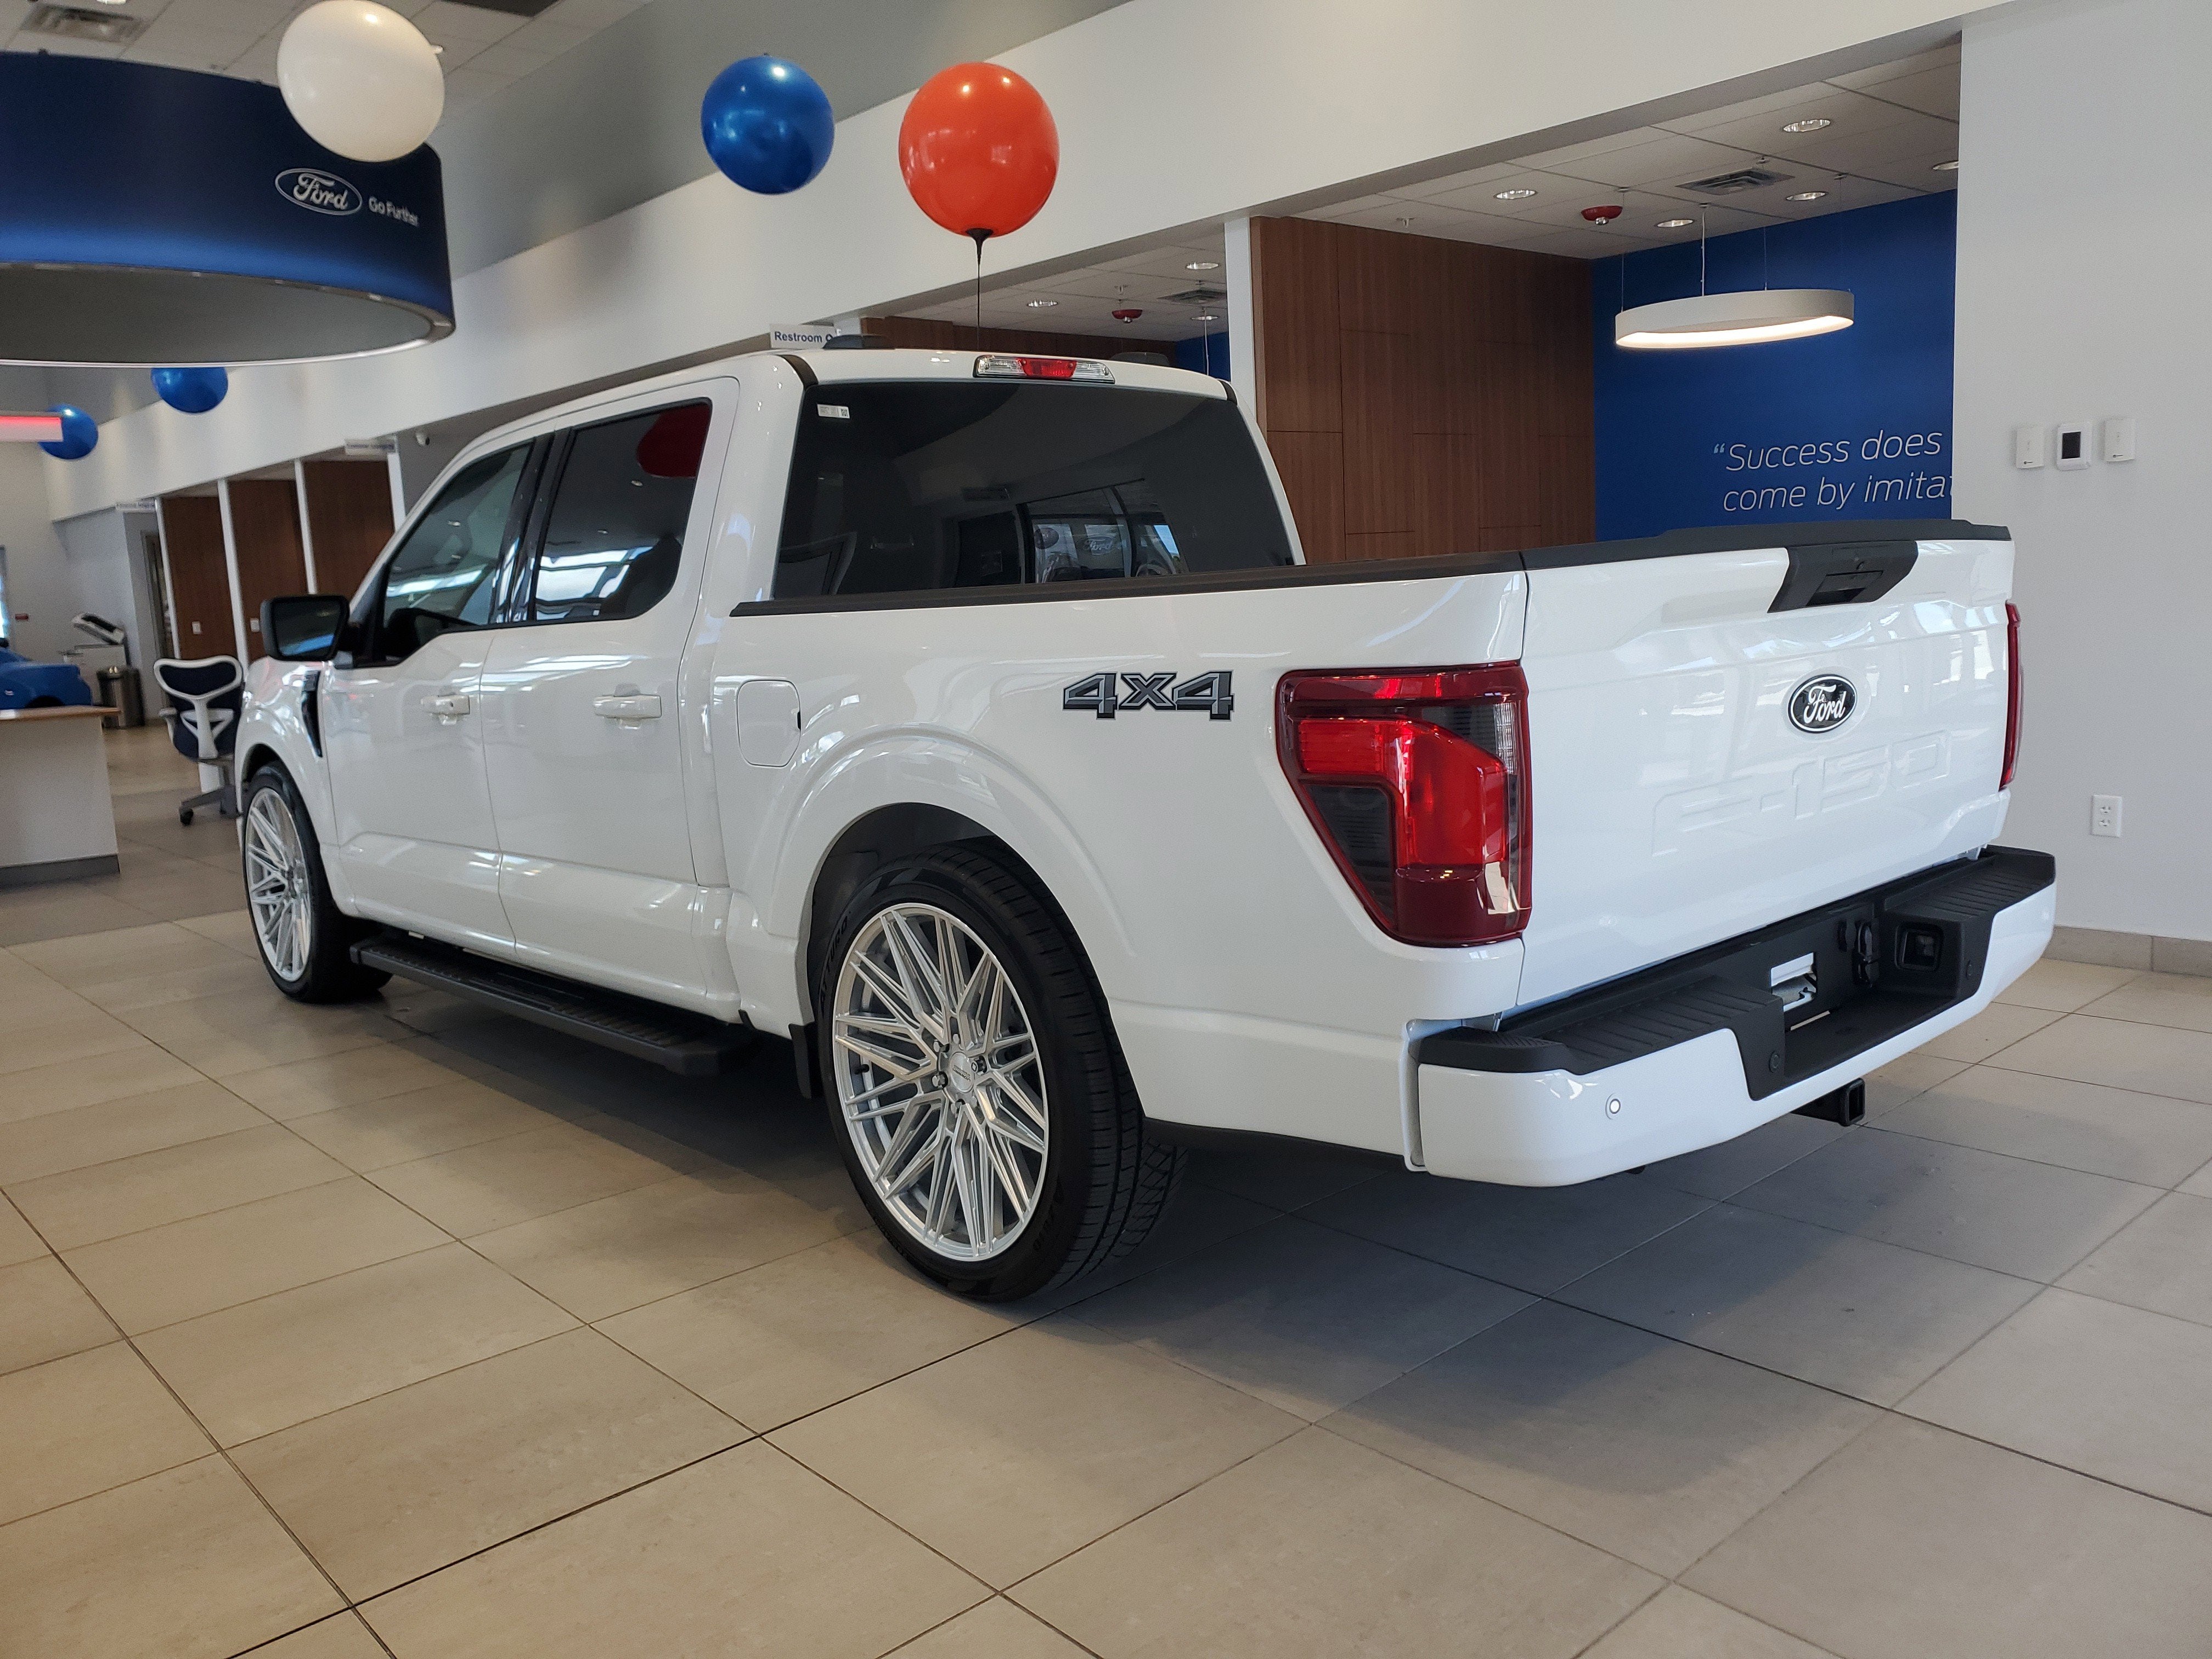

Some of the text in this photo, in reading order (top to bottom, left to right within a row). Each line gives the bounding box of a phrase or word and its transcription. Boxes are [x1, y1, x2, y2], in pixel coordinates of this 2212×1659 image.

[292, 173, 349, 210] Ford
[368, 196, 419, 227] Go Further
[774, 331, 822, 342] Restroom
[1861, 429, 1943, 460] does
[1723, 485, 1806, 511] come
[1817, 477, 1855, 510] by
[1803, 683, 1846, 724] Ford
[1652, 730, 1952, 856] F-150
